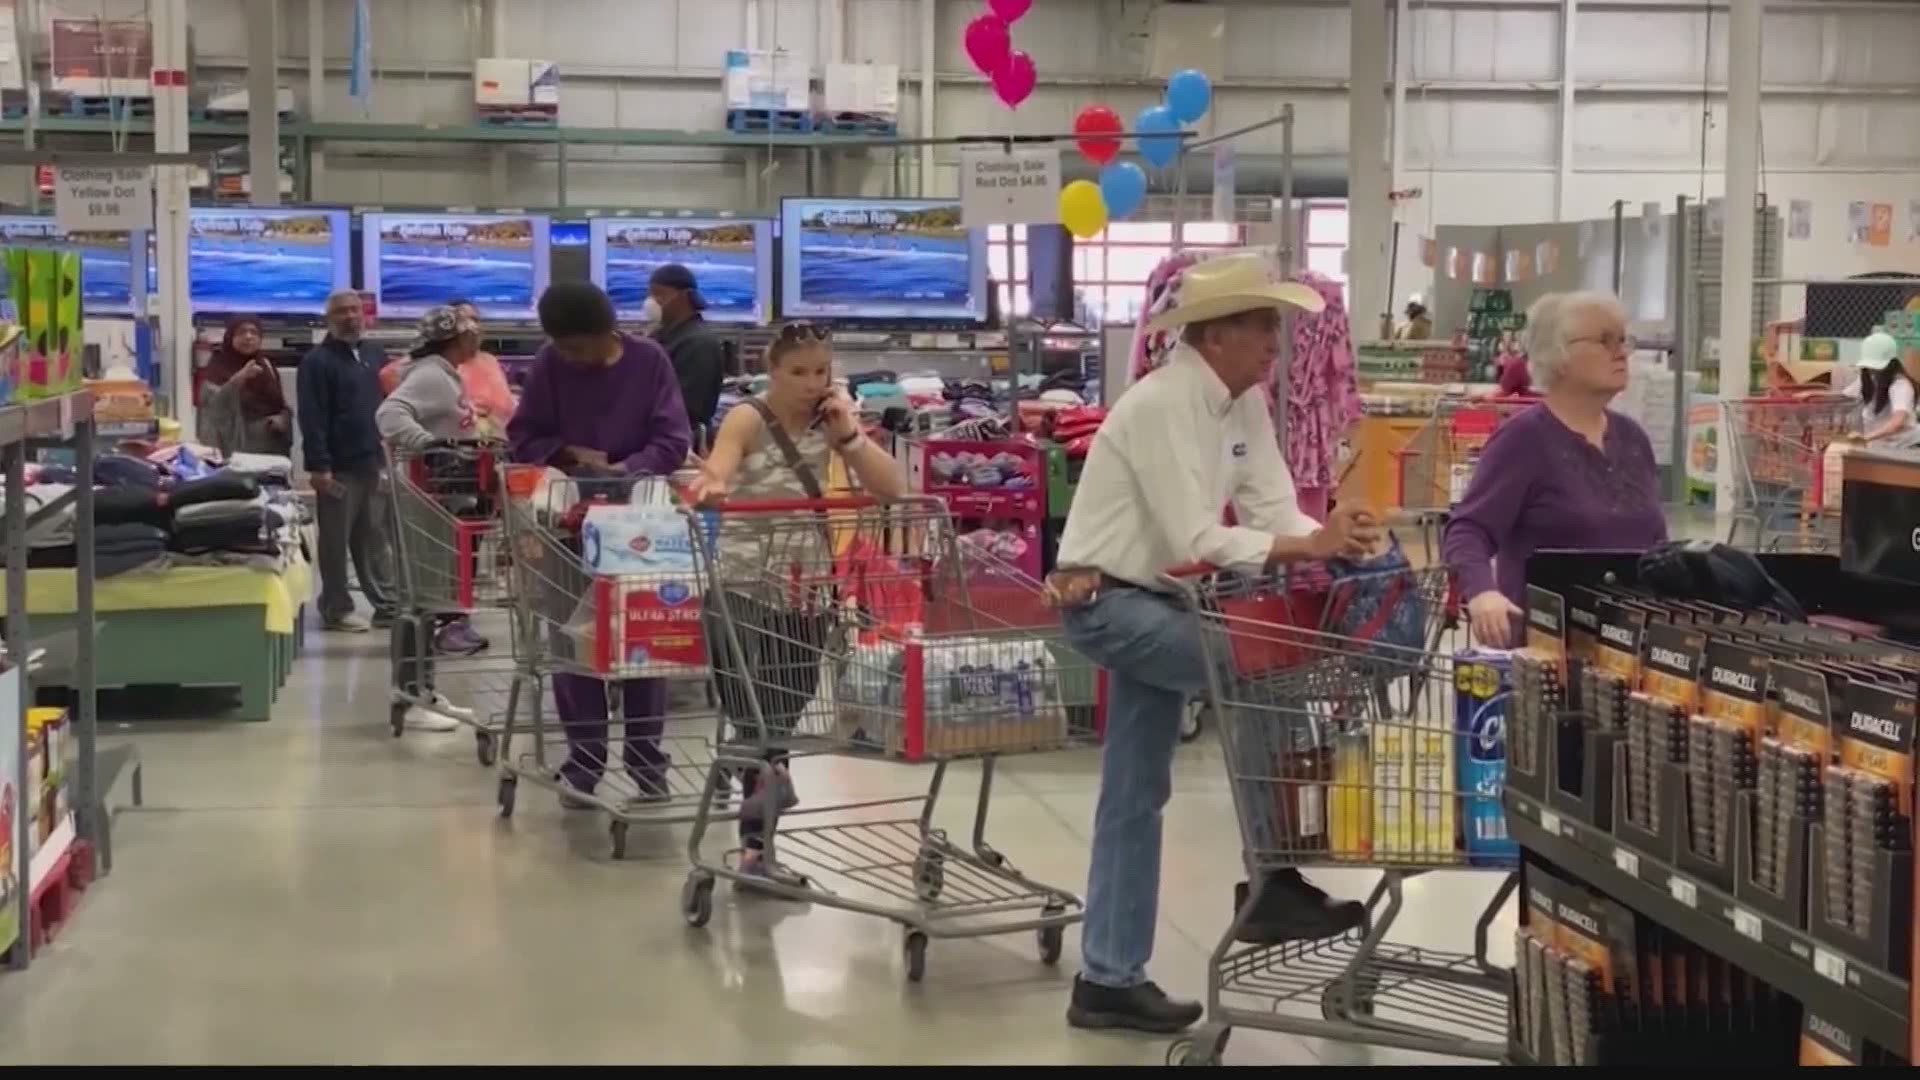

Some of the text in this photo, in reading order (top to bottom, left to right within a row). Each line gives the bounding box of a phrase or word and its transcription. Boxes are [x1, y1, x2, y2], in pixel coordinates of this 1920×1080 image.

[62, 166, 113, 184] Clothing
[976, 175, 997, 188] Red
[1000, 175, 1018, 188] Dot
[71, 186, 136, 199] Yellow Dot
[1601, 624, 1634, 646] DURACELL
[1651, 647, 1691, 672] DURACELL
[1712, 666, 1758, 693] DURACELL
[1850, 711, 1903, 742] DURACELL
[1558, 902, 1601, 936] DURACELL
[1808, 1013, 1853, 1053] DURACELL
